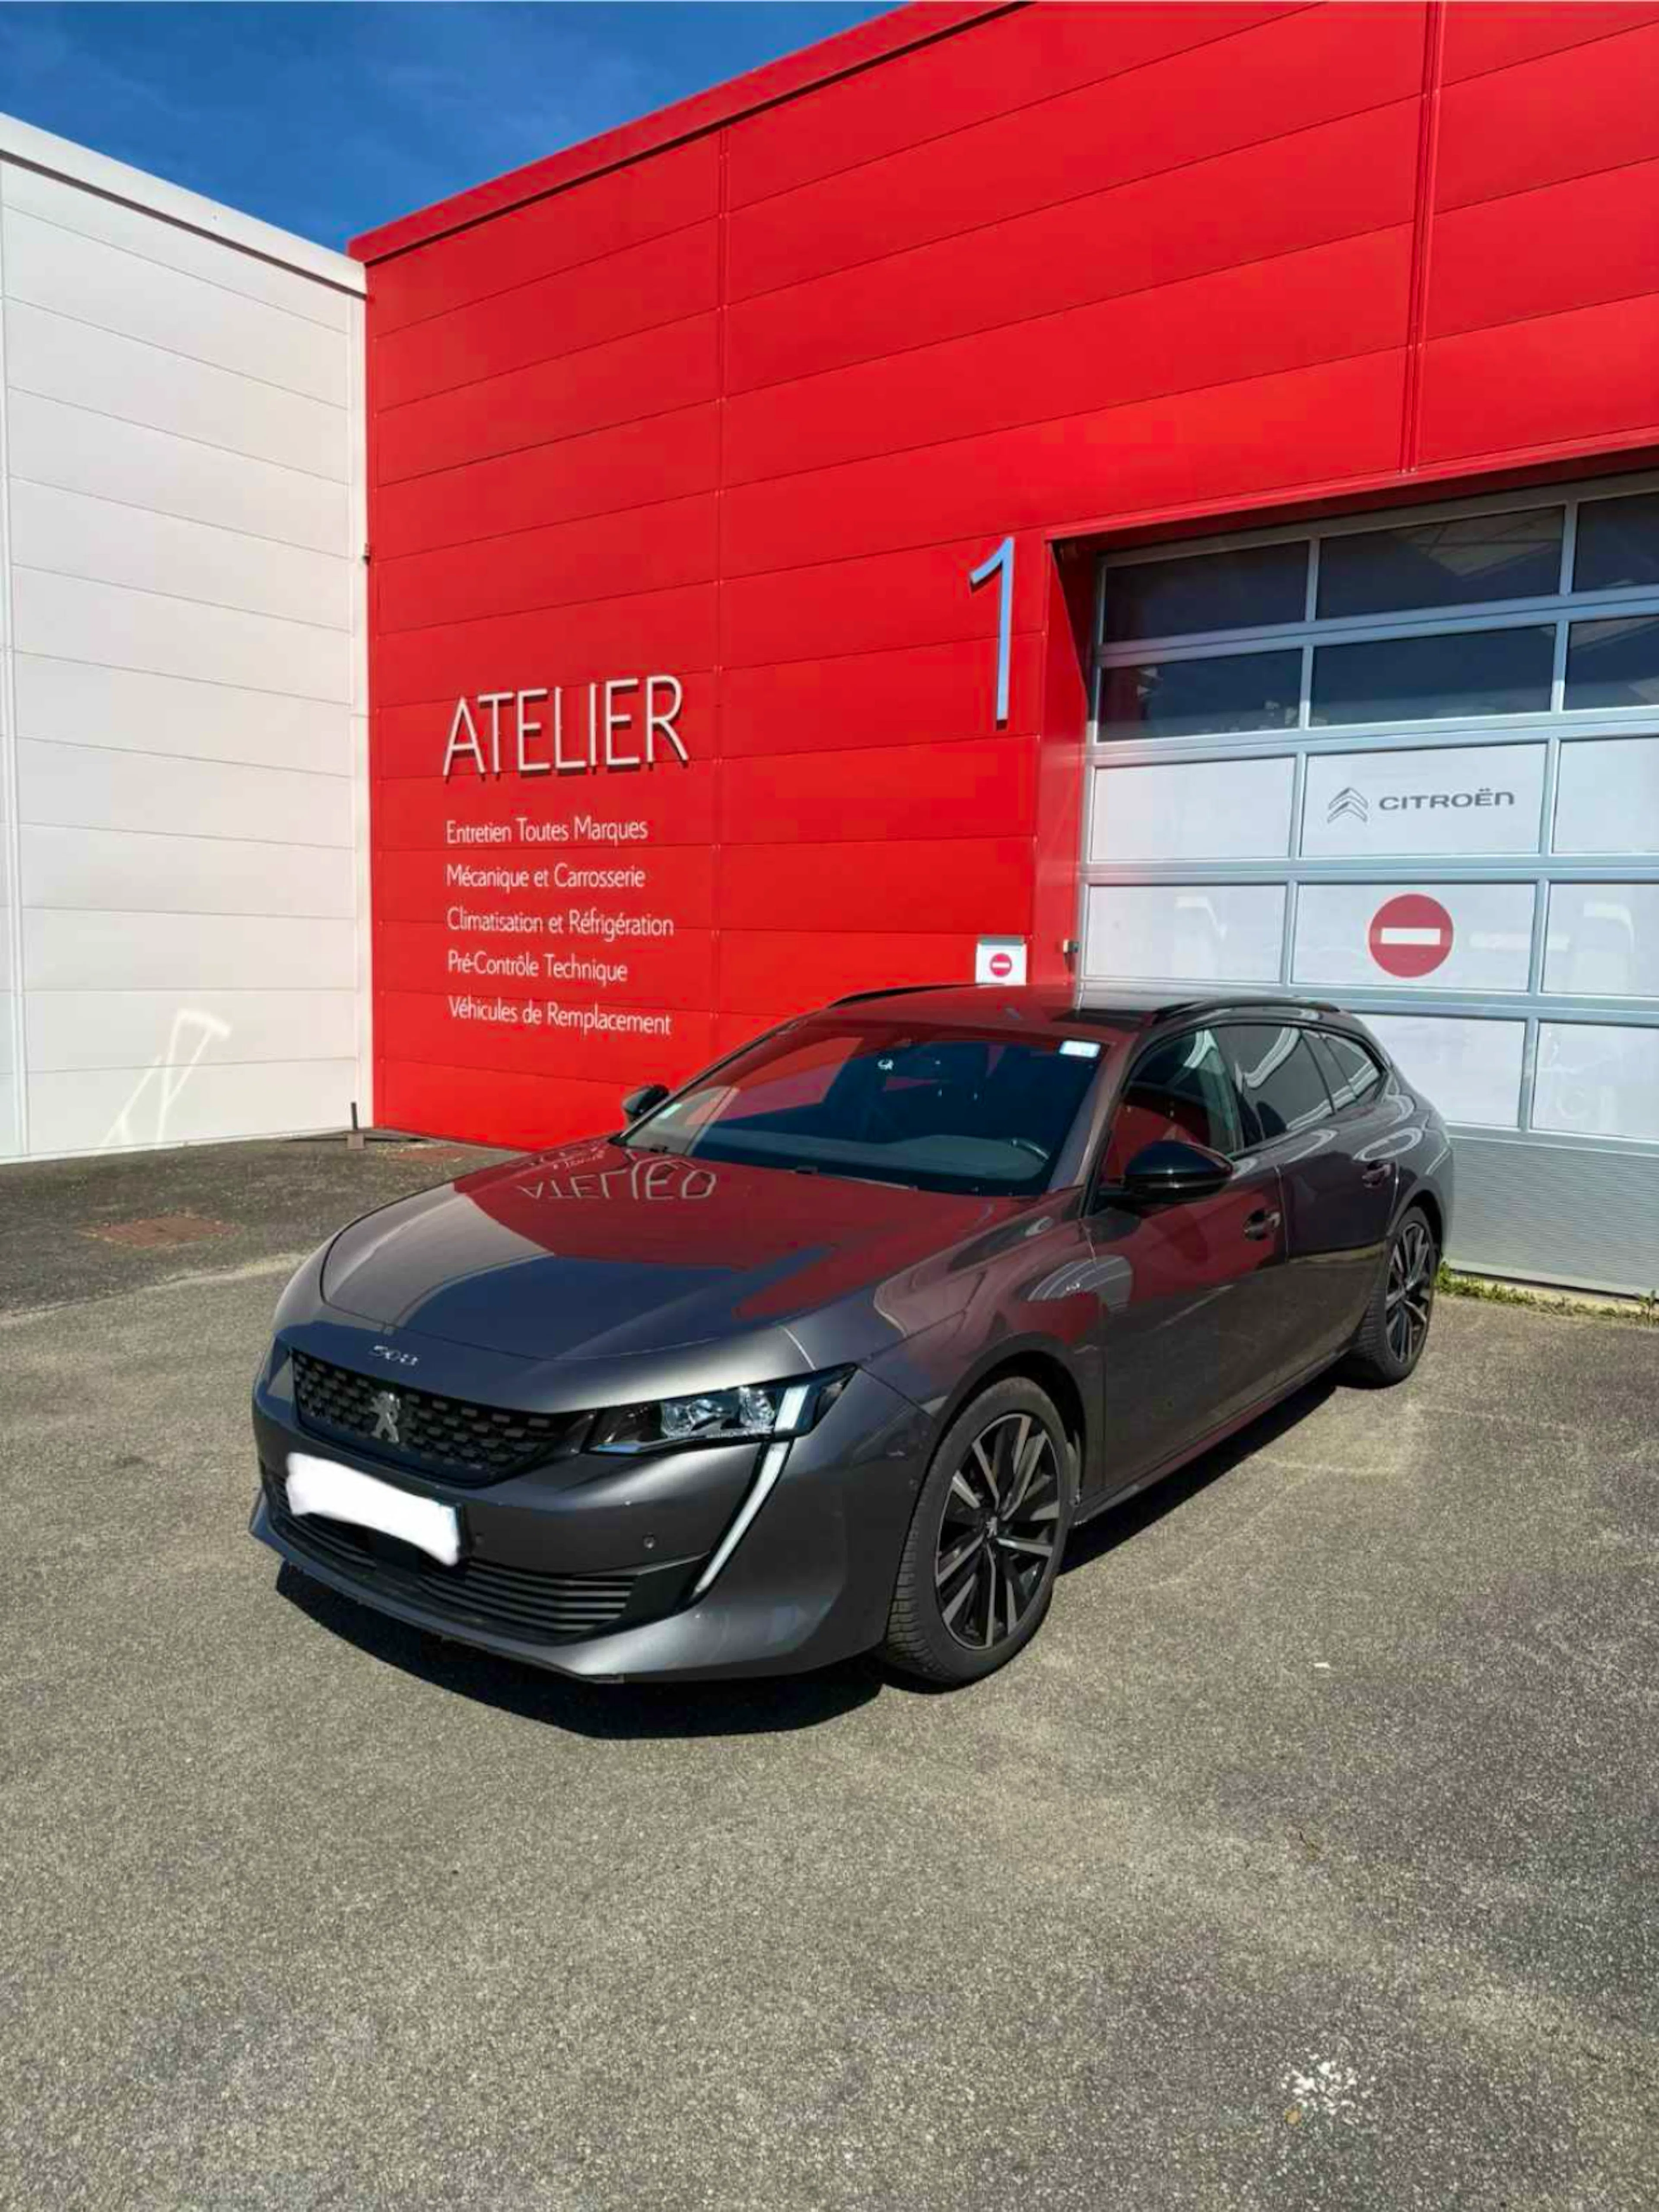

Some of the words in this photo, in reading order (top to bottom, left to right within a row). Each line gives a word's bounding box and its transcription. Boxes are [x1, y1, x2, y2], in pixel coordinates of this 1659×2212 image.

[970, 537, 1014, 720] 1
[443, 675, 689, 777] ATELIER
[447, 820, 512, 844] Entretien
[517, 818, 569, 842] Toutes
[574, 816, 648, 846] Marques
[447, 864, 530, 893] Mécanique
[534, 871, 550, 887] et
[554, 863, 646, 887] Carrosserie
[447, 907, 543, 933] Climatisation
[549, 914, 564, 933] et
[569, 909, 674, 942] Réfrigération
[448, 950, 539, 977] Pré-Contrôle
[545, 954, 628, 987] Technique
[448, 996, 518, 1023] Véhicules
[523, 1000, 543, 1025] de
[547, 1002, 673, 1035] Remplacement
